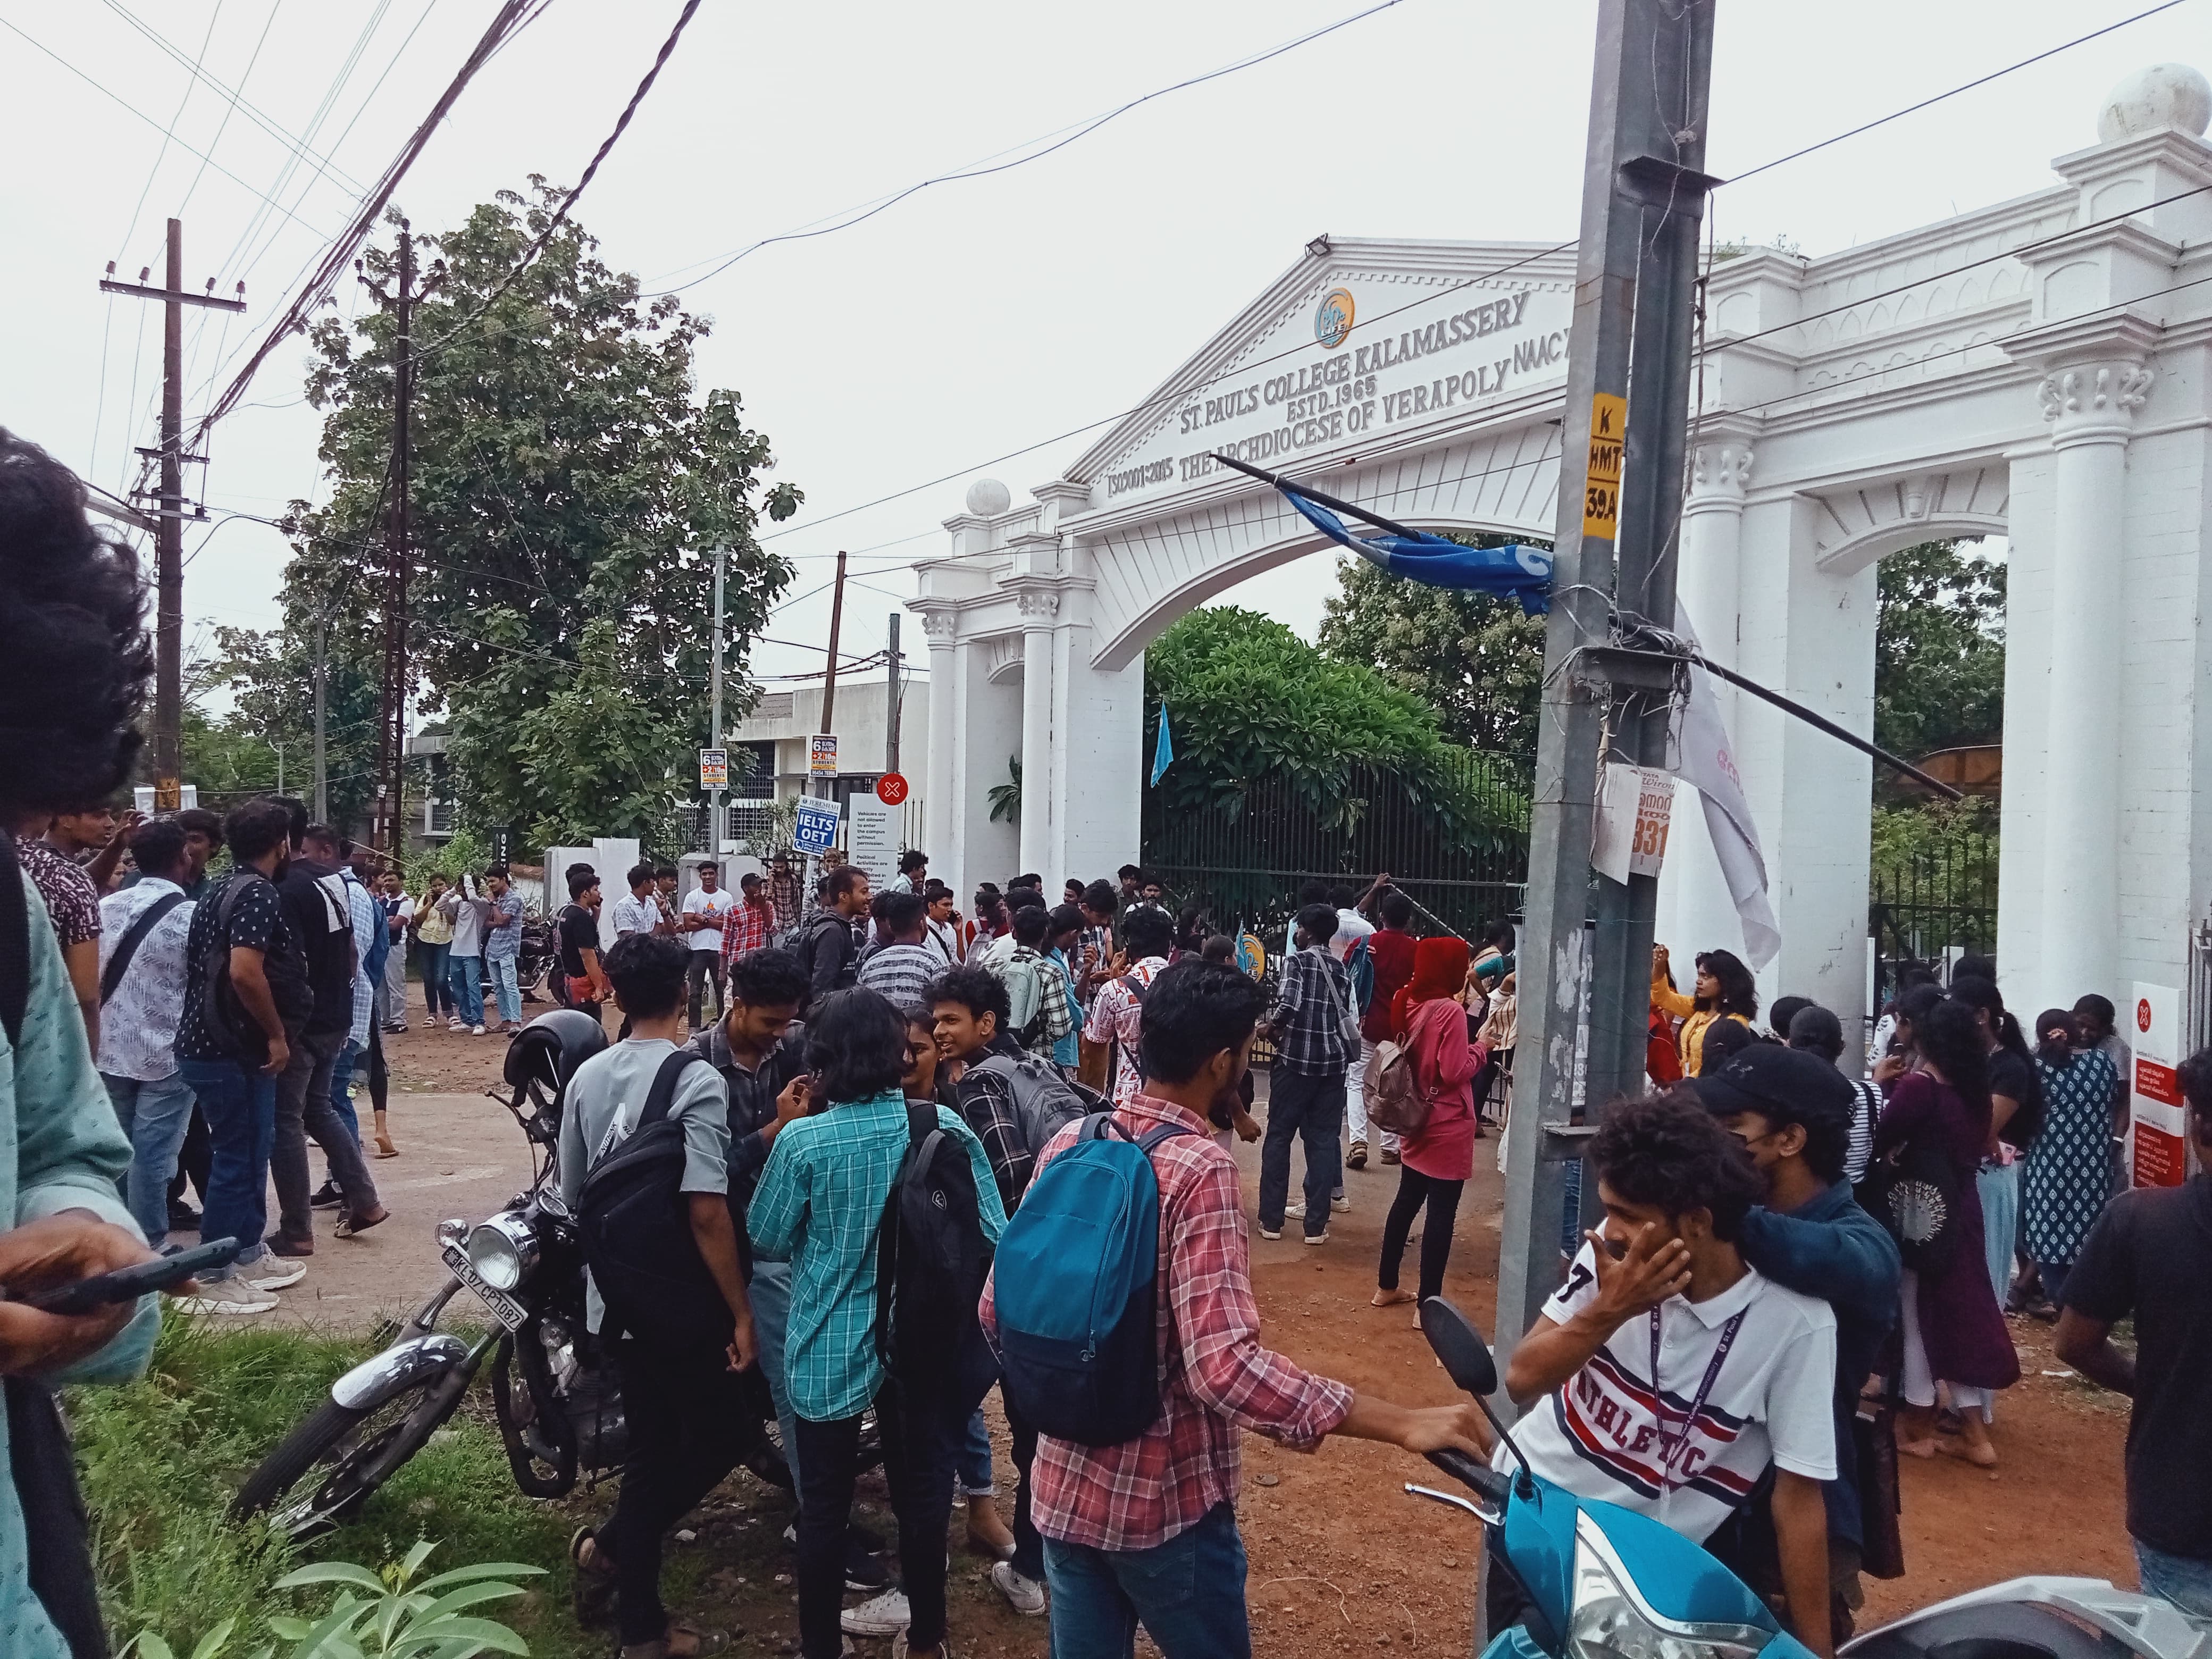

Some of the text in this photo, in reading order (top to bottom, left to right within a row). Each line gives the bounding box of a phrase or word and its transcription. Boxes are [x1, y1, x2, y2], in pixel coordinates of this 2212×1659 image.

[1321, 324, 1345, 337] LIFE
[1205, 384, 1260, 426] PAUL'S
[1264, 353, 1351, 405] COLLEGE
[1354, 290, 1530, 376] KALAMASSERY
[1514, 332, 1562, 374] NAAC
[1179, 358, 1511, 481] THE ARCHDIOCESE OF VERAPOLY
[1600, 406, 1613, 434] K
[1589, 444, 1622, 474] HMT
[1586, 486, 1616, 523] 39A
[813, 740, 822, 751] 6
[703, 755, 711, 766] 6
[1642, 777, 1675, 790] Wiron
[808, 800, 839, 810] JEREMIAH
[799, 814, 834, 831] IELTS
[801, 828, 828, 843] OET
[601, 1121, 617, 1153] NUTHINK
[455, 1259, 521, 1323] KL 07 CP 1087
[1556, 1263, 1594, 1302] 7
